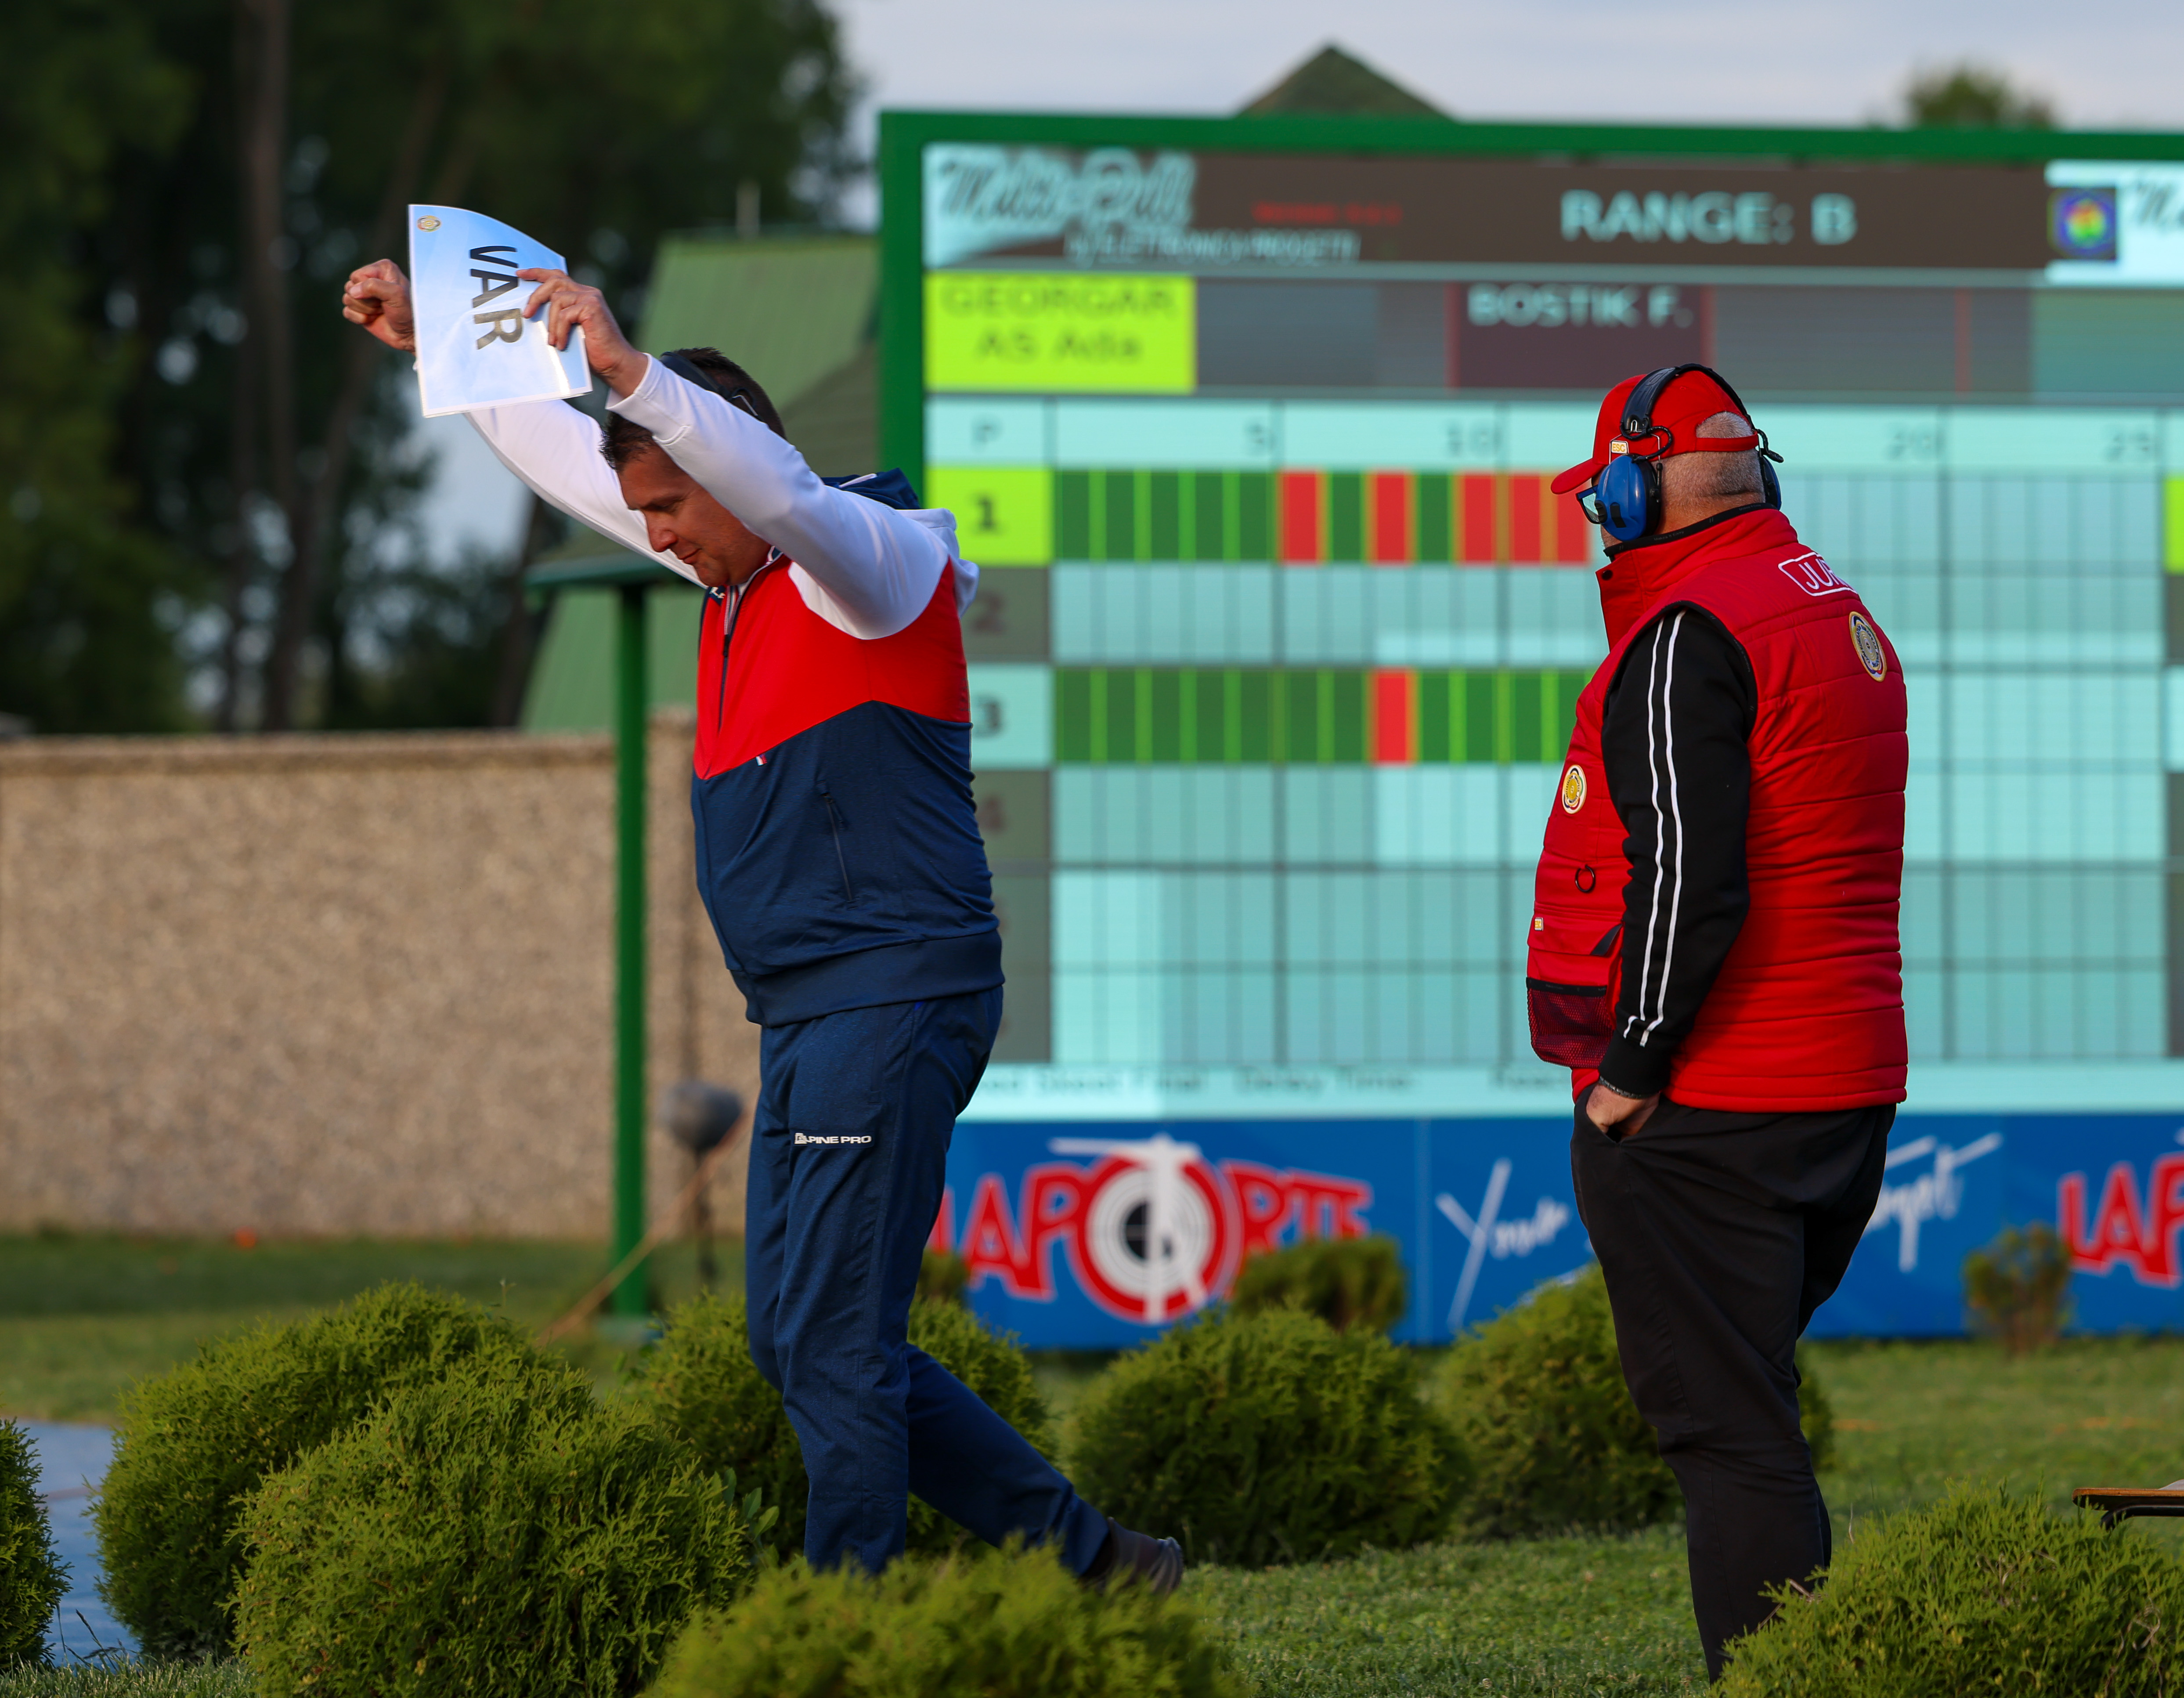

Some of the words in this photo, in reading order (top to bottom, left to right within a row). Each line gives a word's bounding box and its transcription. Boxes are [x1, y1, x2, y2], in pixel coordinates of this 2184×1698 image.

[1560, 189, 1794, 245] RANGE:
[1811, 193, 1858, 245] B
[470, 246, 523, 350] VAR
[1467, 282, 1641, 327] BOSTIK
[1612, 443, 1625, 452] ESC
[972, 492, 1005, 535] 1
[841, 1135, 872, 1144] PRO
